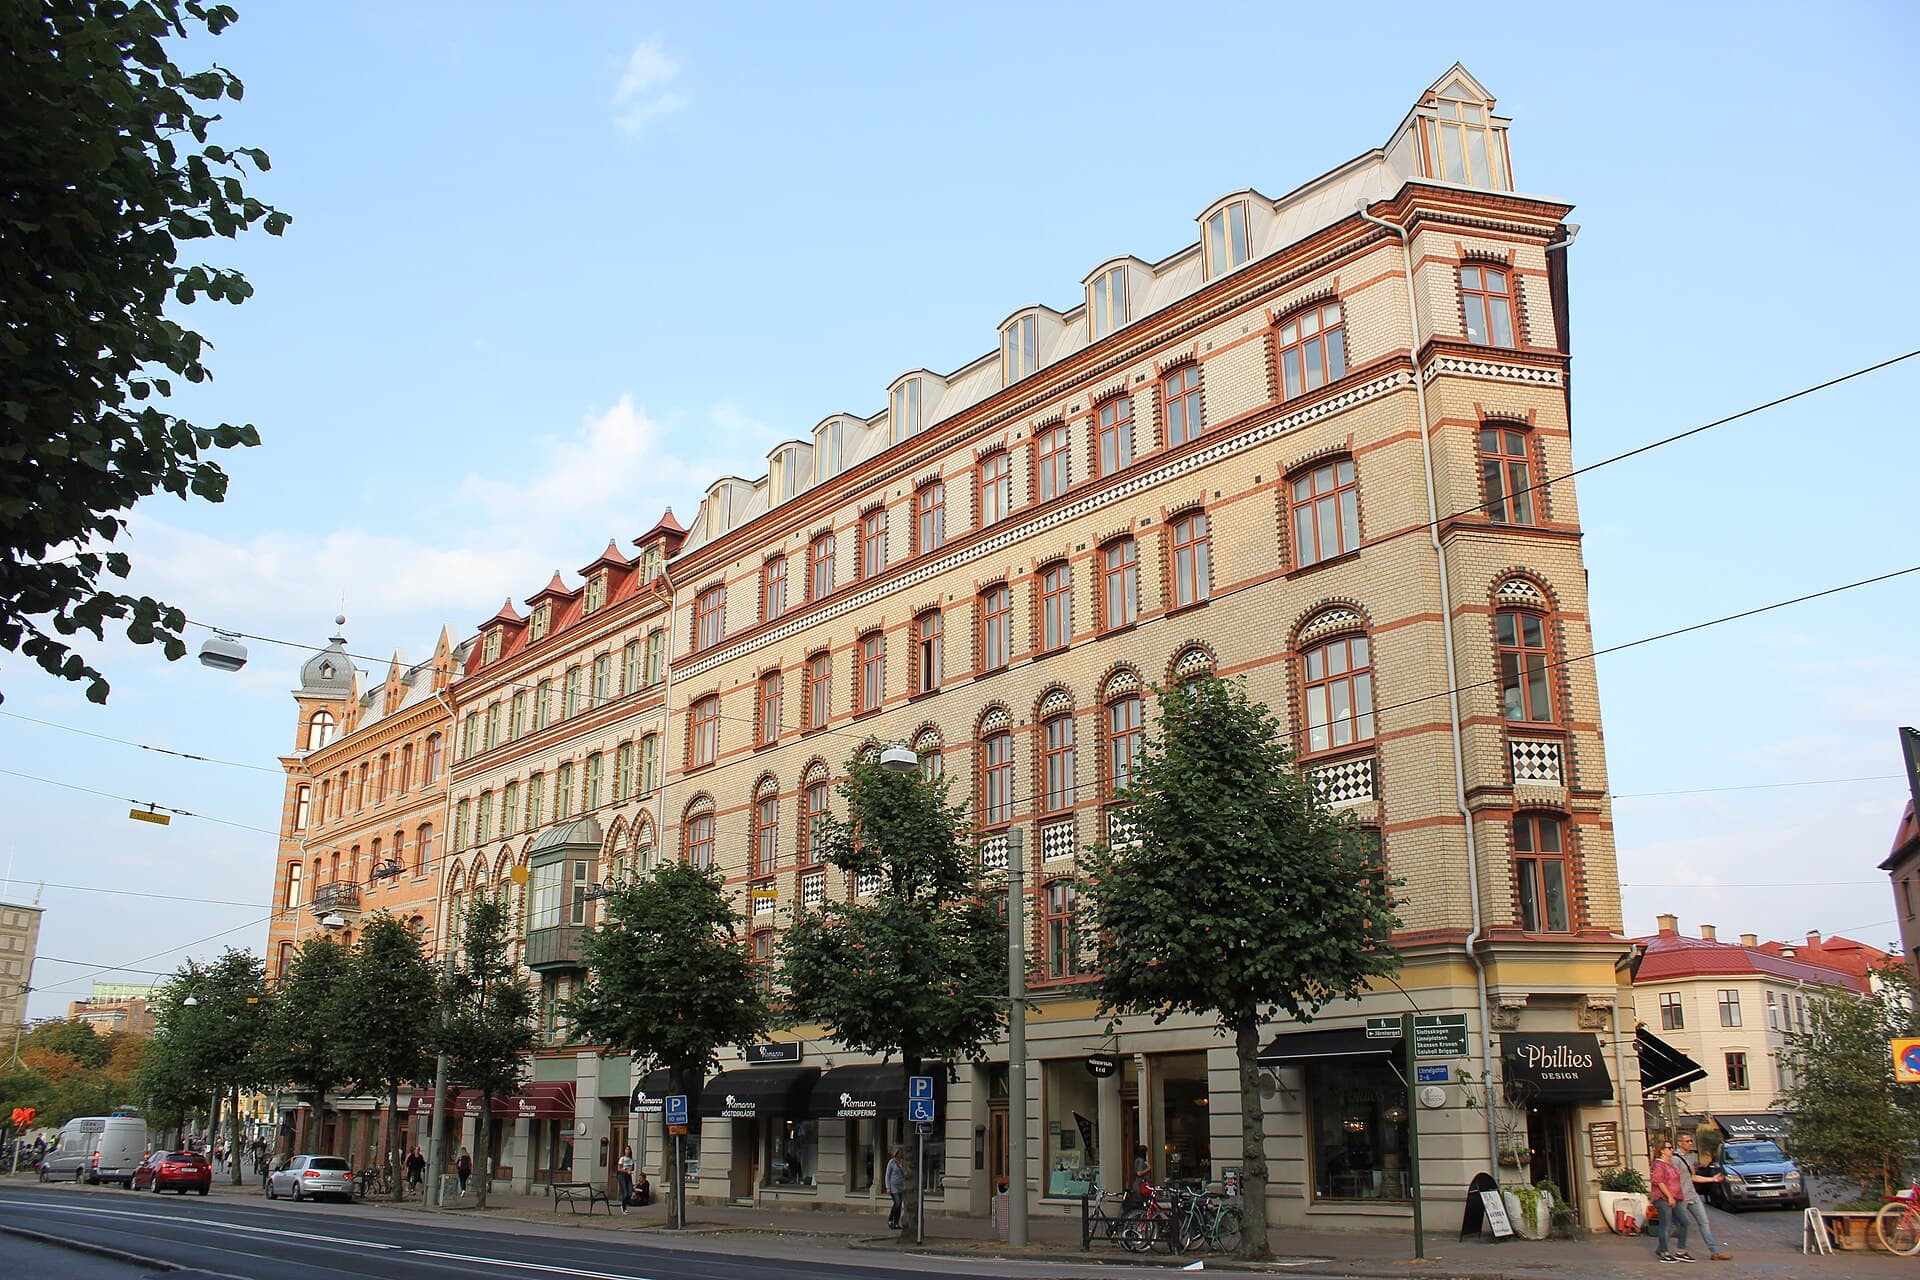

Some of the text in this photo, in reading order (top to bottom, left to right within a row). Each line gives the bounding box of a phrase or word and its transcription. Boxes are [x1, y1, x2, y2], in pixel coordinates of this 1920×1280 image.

[1416, 1028, 1449, 1036] Slottsskogen
[1517, 1044, 1593, 1068] Phillies
[1541, 1072, 1579, 1080] DESIGN
[916, 1079, 927, 1097] P
[671, 1098, 681, 1112] P
[840, 1093, 877, 1108] Romanns
[837, 1109, 877, 1117] HERREKIPERING
